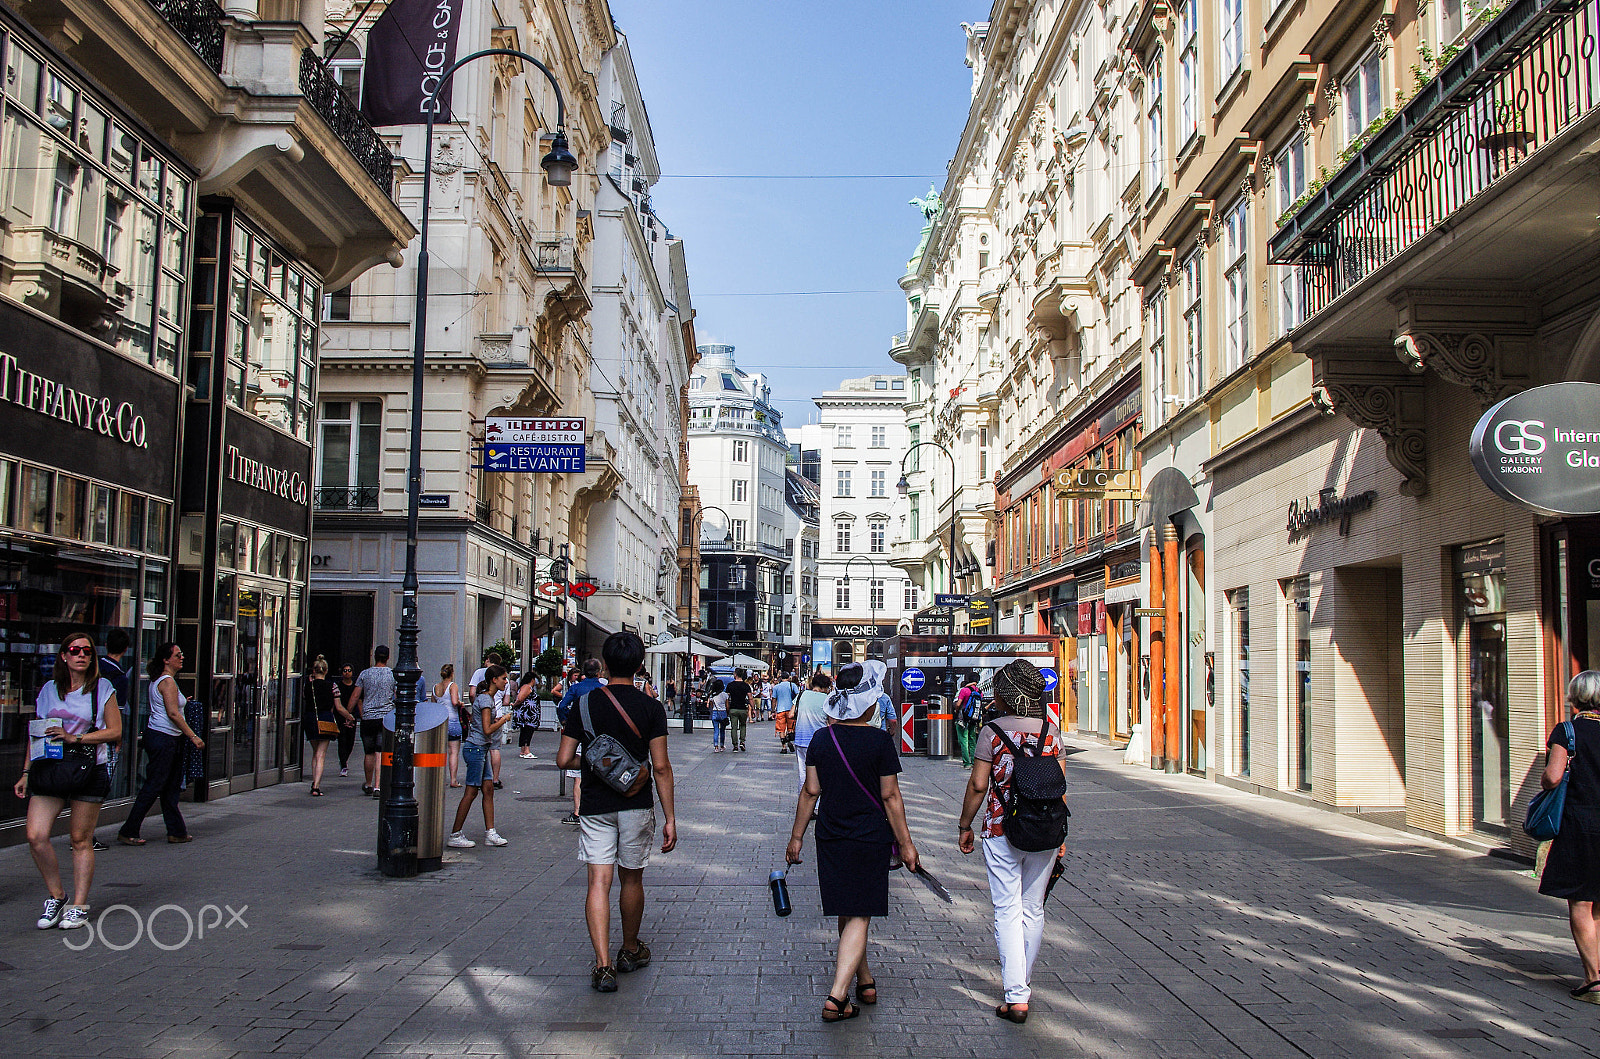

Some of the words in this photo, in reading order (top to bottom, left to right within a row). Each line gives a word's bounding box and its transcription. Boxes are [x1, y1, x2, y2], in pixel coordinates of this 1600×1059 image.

[420, 42, 447, 113] DOLCE
[437, 29, 448, 39] &
[1494, 419, 1547, 455] GS
[1554, 427, 1600, 443] Intern
[509, 446, 580, 456] RESTAURANT
[509, 457, 581, 470] LEVANTE
[1500, 456, 1542, 464] GALLERY
[1500, 466, 1542, 474] SIKABONYI
[1058, 472, 1136, 486] GUCCI
[834, 625, 878, 636] WAGNER
